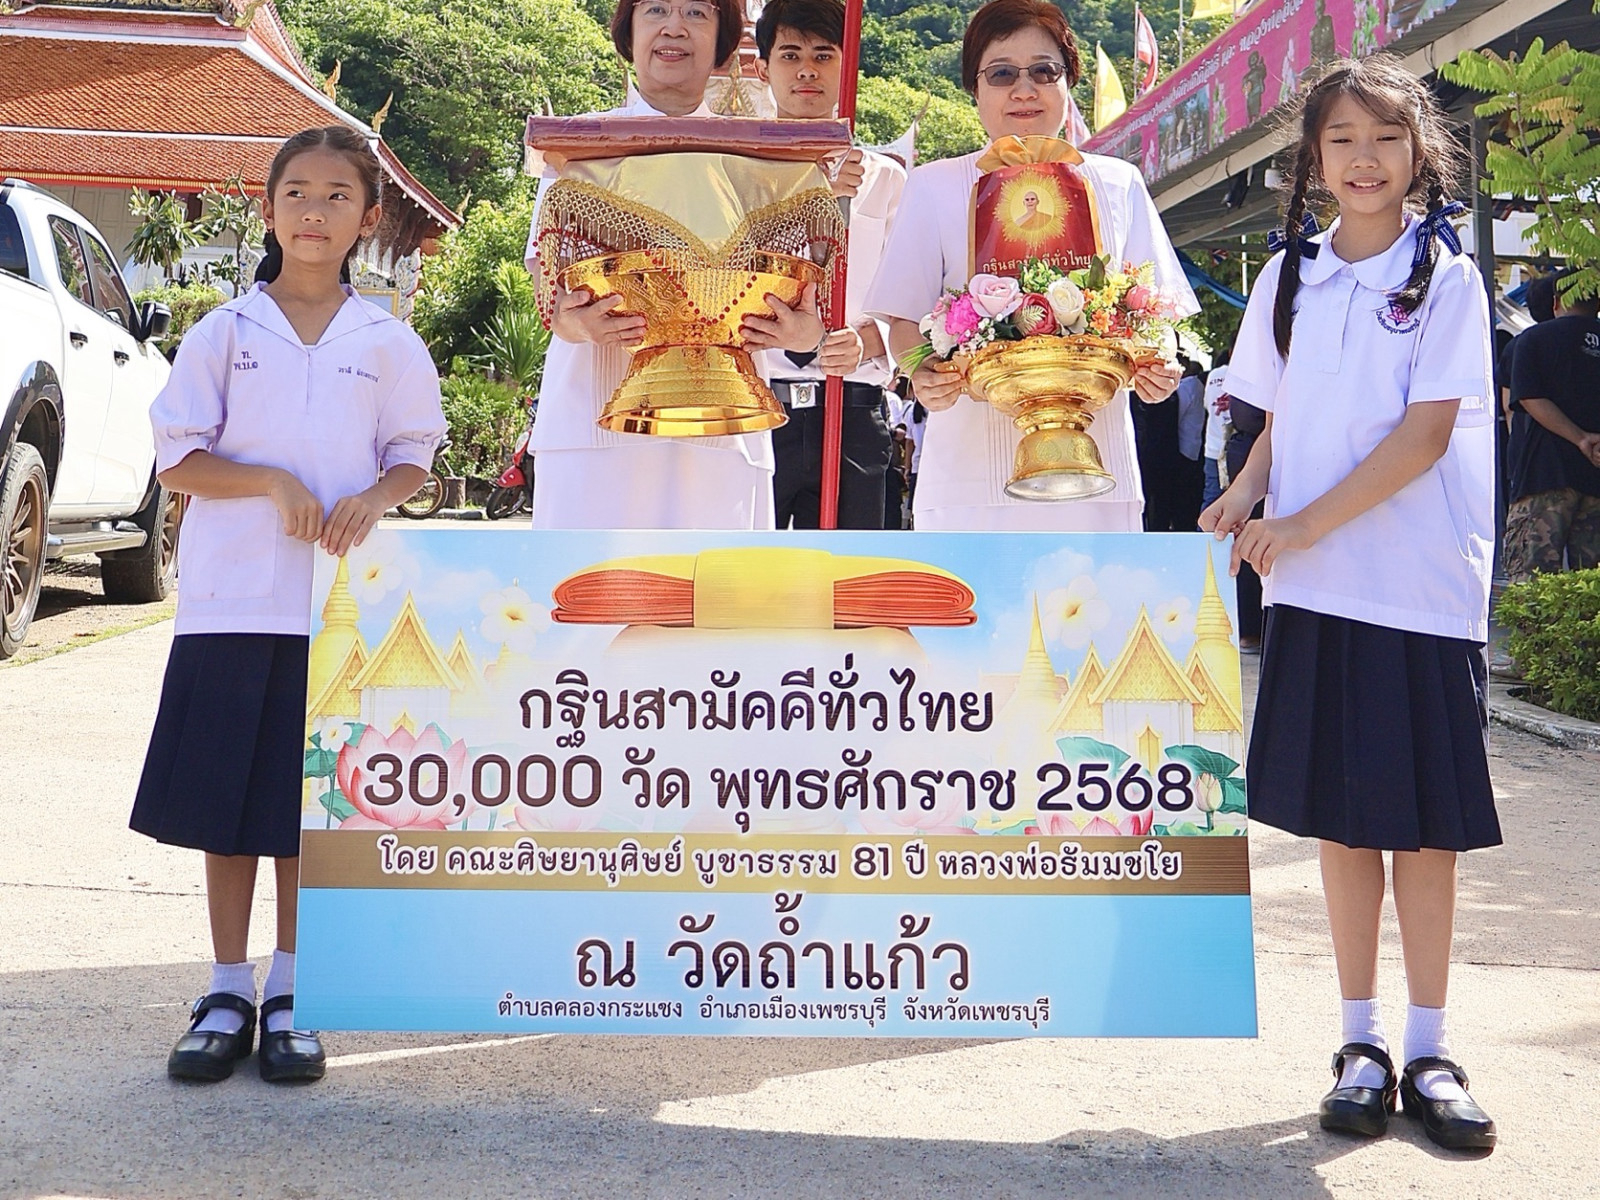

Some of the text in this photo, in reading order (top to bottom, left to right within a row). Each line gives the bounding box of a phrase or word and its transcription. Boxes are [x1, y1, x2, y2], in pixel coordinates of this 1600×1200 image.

[519, 652, 993, 748] กฐินสามัคคีทั่วไทย
[364, 747, 1194, 834] 30,000 วัด พุทธศักราช 2568
[380, 838, 1181, 885] โดย คณะศิษยานุศิษย์ บูชาธรรม 81 ปี หลวงพ่อธัมมชโย
[576, 892, 969, 991] ณ วัดถ้ำแก้ว
[498, 992, 1050, 1029] ตำบลคลองกระแชง อำเภอเมืองเพชรบุรี จังหวัดเพชรบุรี
